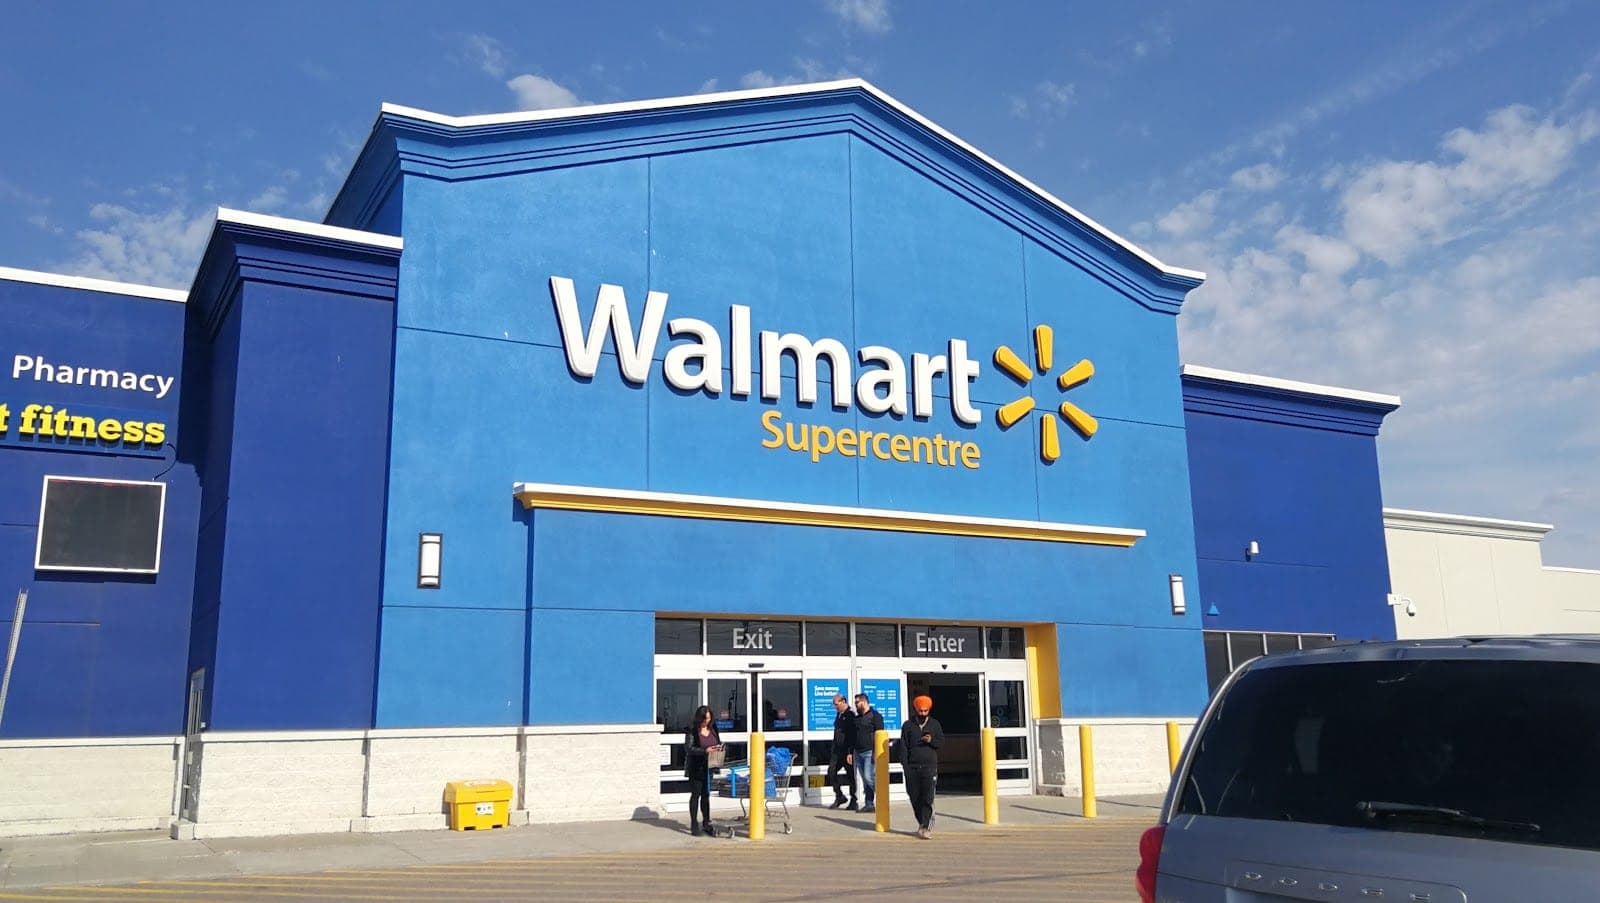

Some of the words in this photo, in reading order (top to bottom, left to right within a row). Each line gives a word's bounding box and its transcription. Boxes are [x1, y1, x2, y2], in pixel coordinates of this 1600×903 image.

[550, 275, 982, 425] Walmart
[12, 354, 174, 398] Pharmacy
[19, 404, 165, 444] fitness
[761, 410, 981, 468] Supercentre
[732, 627, 773, 649] Exit
[915, 632, 965, 653] Enter
